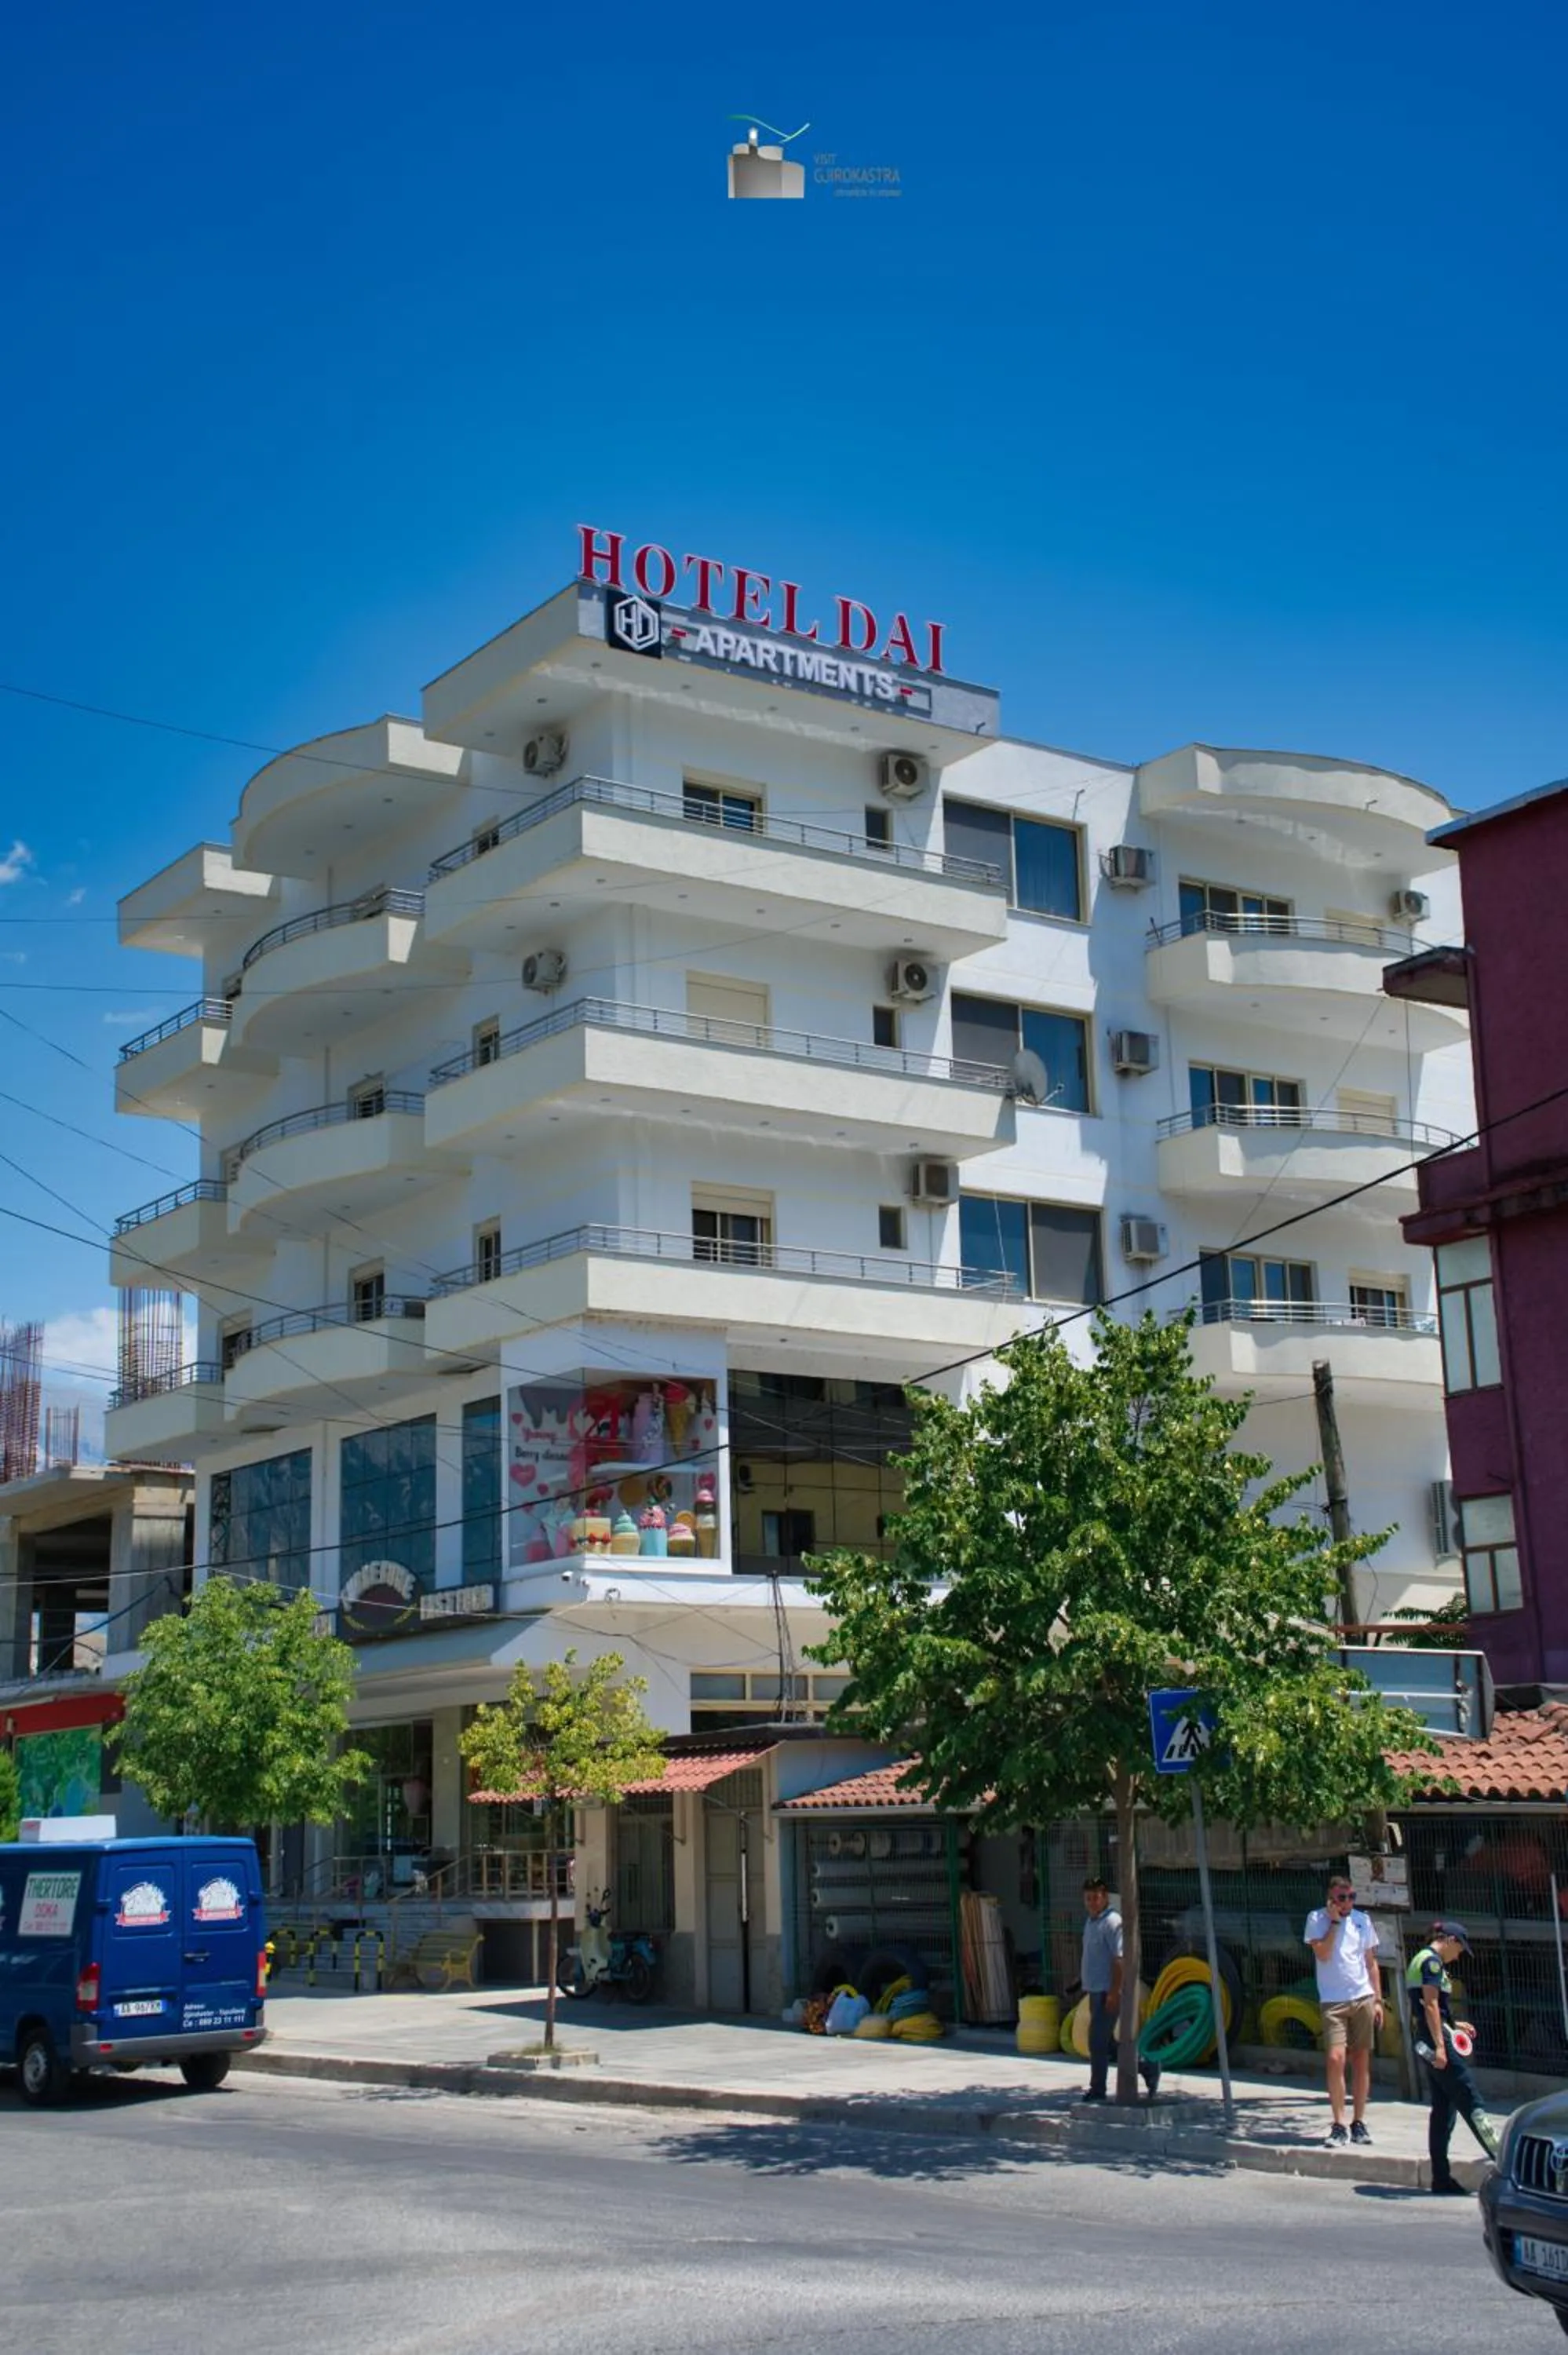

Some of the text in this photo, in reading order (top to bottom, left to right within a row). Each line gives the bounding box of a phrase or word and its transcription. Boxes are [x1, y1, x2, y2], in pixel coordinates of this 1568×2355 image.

[577, 524, 946, 674] HOTEL DAI
[695, 626, 898, 701] APARTMENTS
